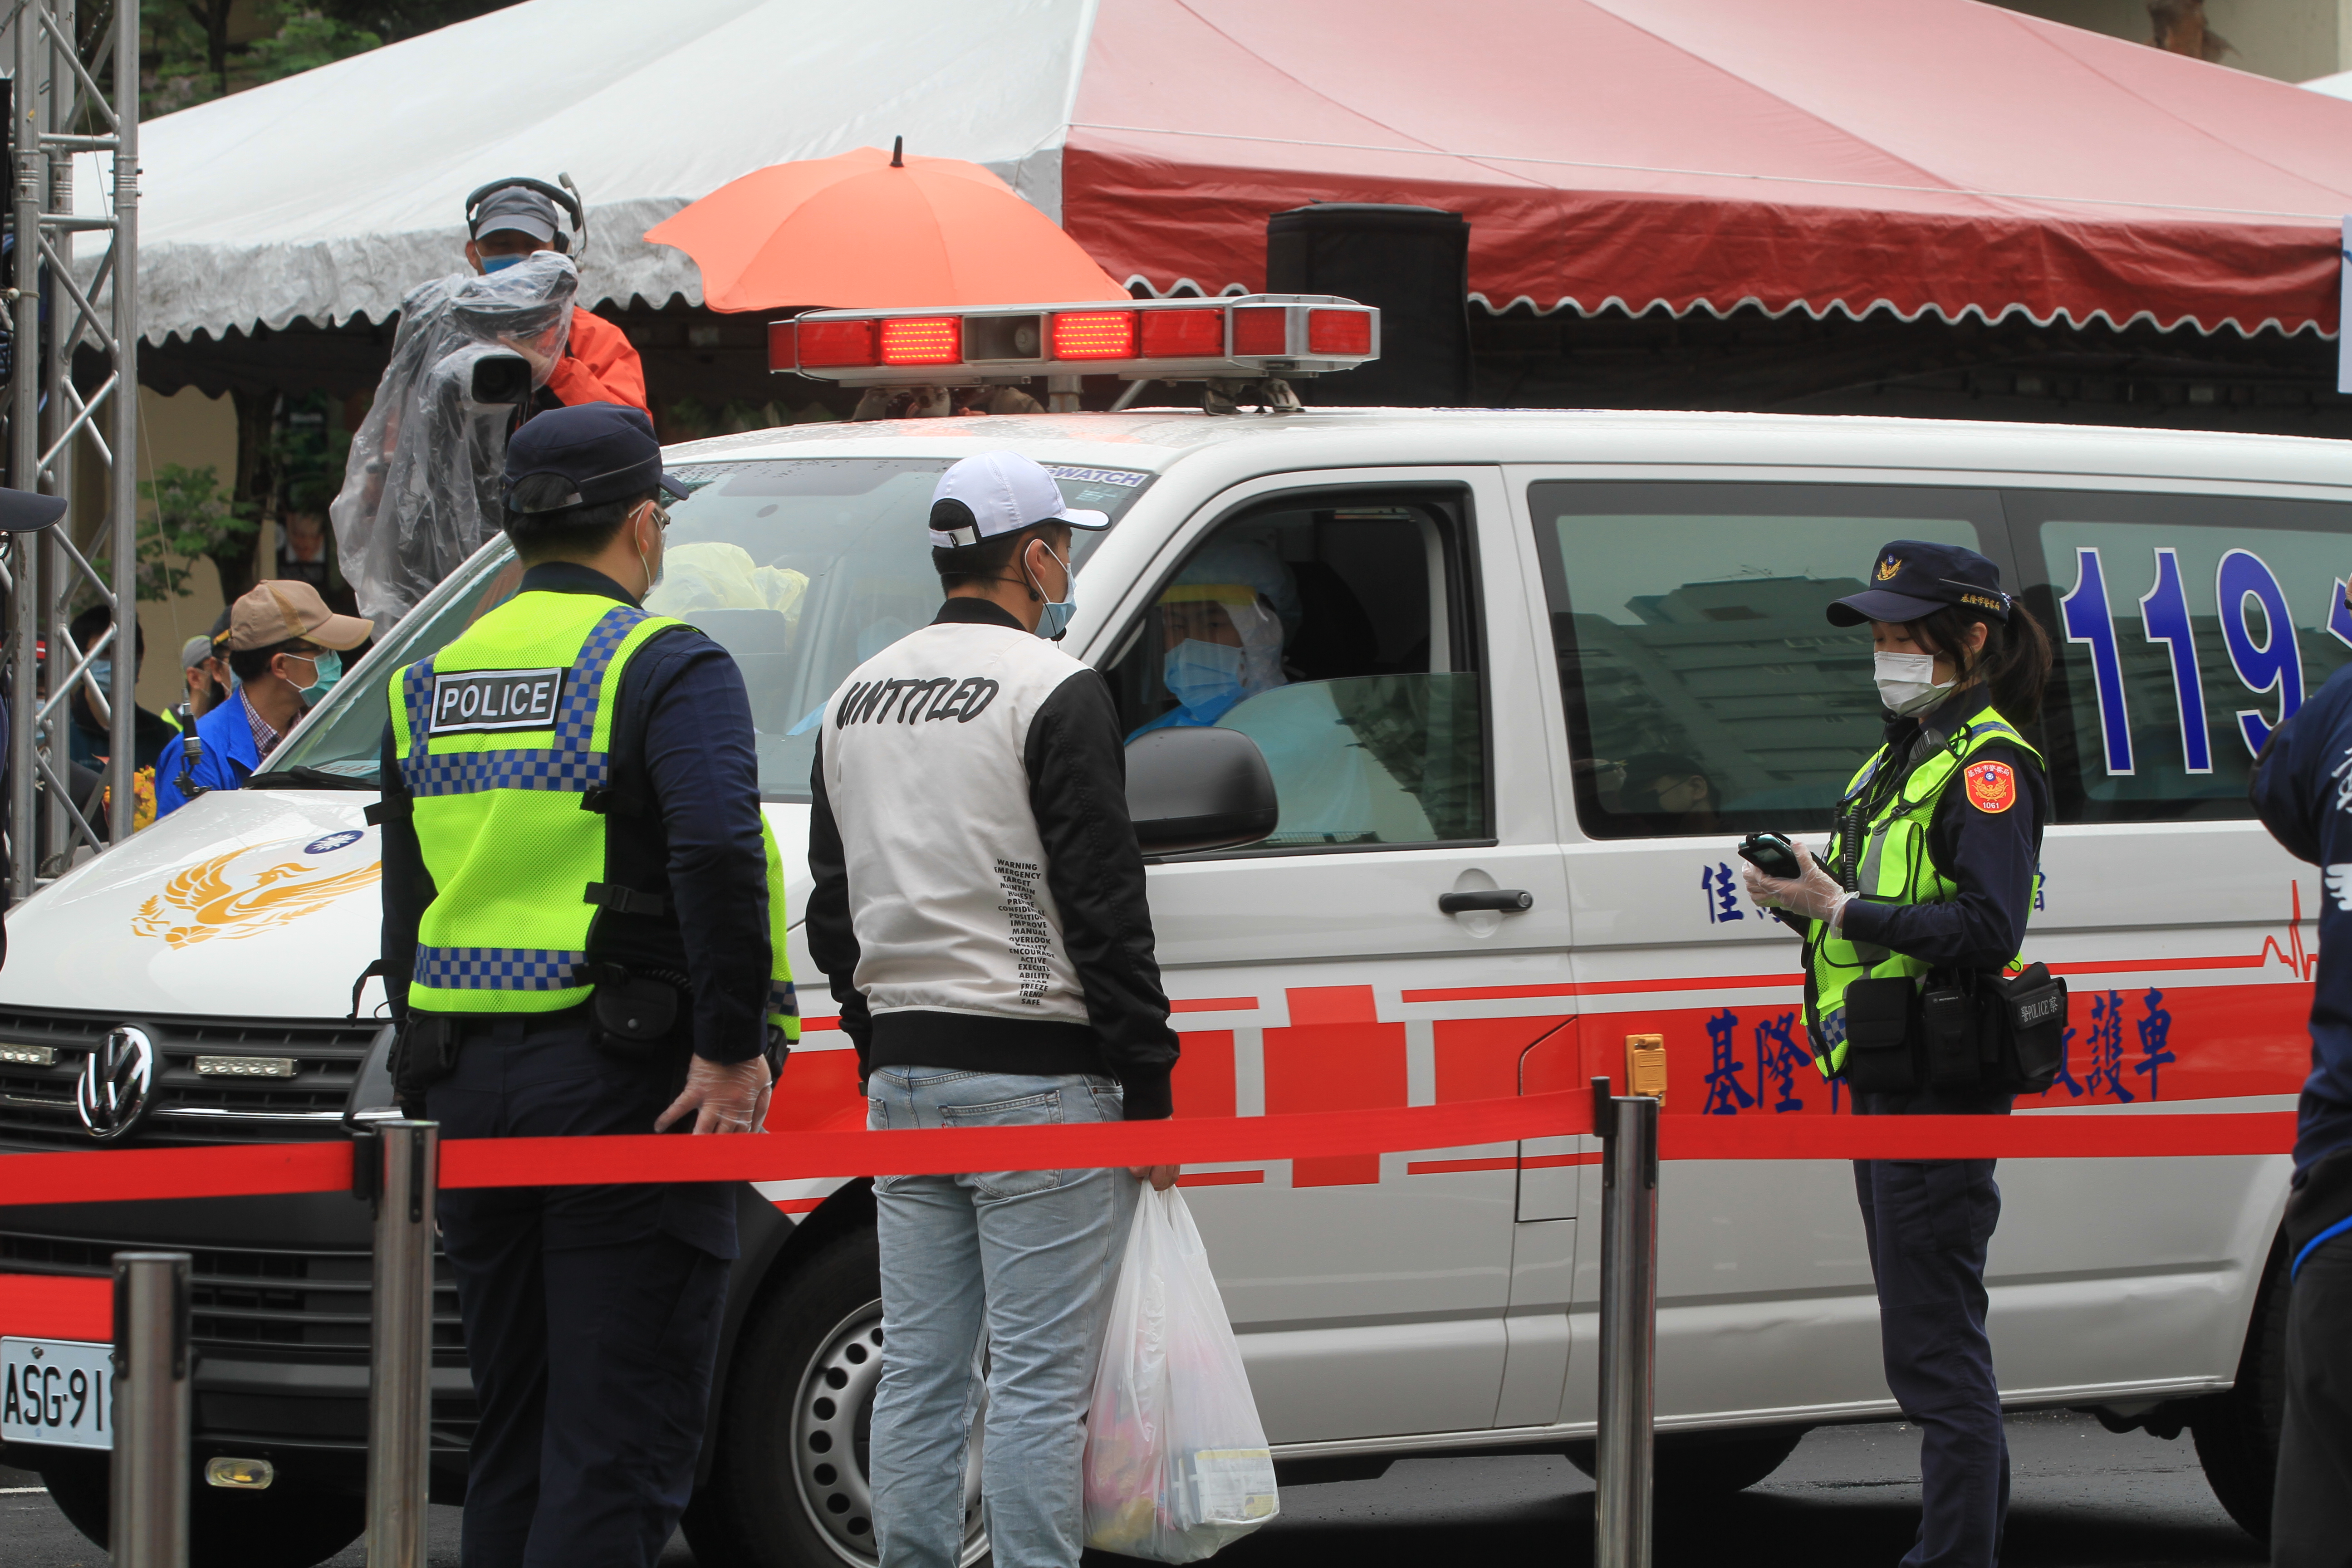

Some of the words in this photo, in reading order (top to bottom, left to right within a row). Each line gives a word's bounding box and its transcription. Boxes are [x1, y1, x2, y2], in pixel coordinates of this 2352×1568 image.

[1044, 466, 1143, 485] eWATCH
[1960, 593, 1999, 611] 基隆市警察局
[2059, 547, 2305, 775] 119
[441, 682, 550, 720] POLICE
[837, 677, 999, 730] UNTITLED
[1967, 764, 2010, 778] 基隆市警察局
[997, 858, 1038, 871] WARNING
[994, 867, 1041, 879] EMERGENCY
[1003, 876, 1031, 887] TARGET
[1000, 882, 1035, 895] MAINTAIN
[1010, 920, 1047, 928] IMPROVE
[1012, 928, 1047, 936] MANUAL
[1009, 948, 1055, 959] ENCOURAGE
[1021, 956, 1047, 965] ACTIVE
[1021, 983, 1049, 992] FREEZE
[5, 1361, 113, 1431] ASG-91
